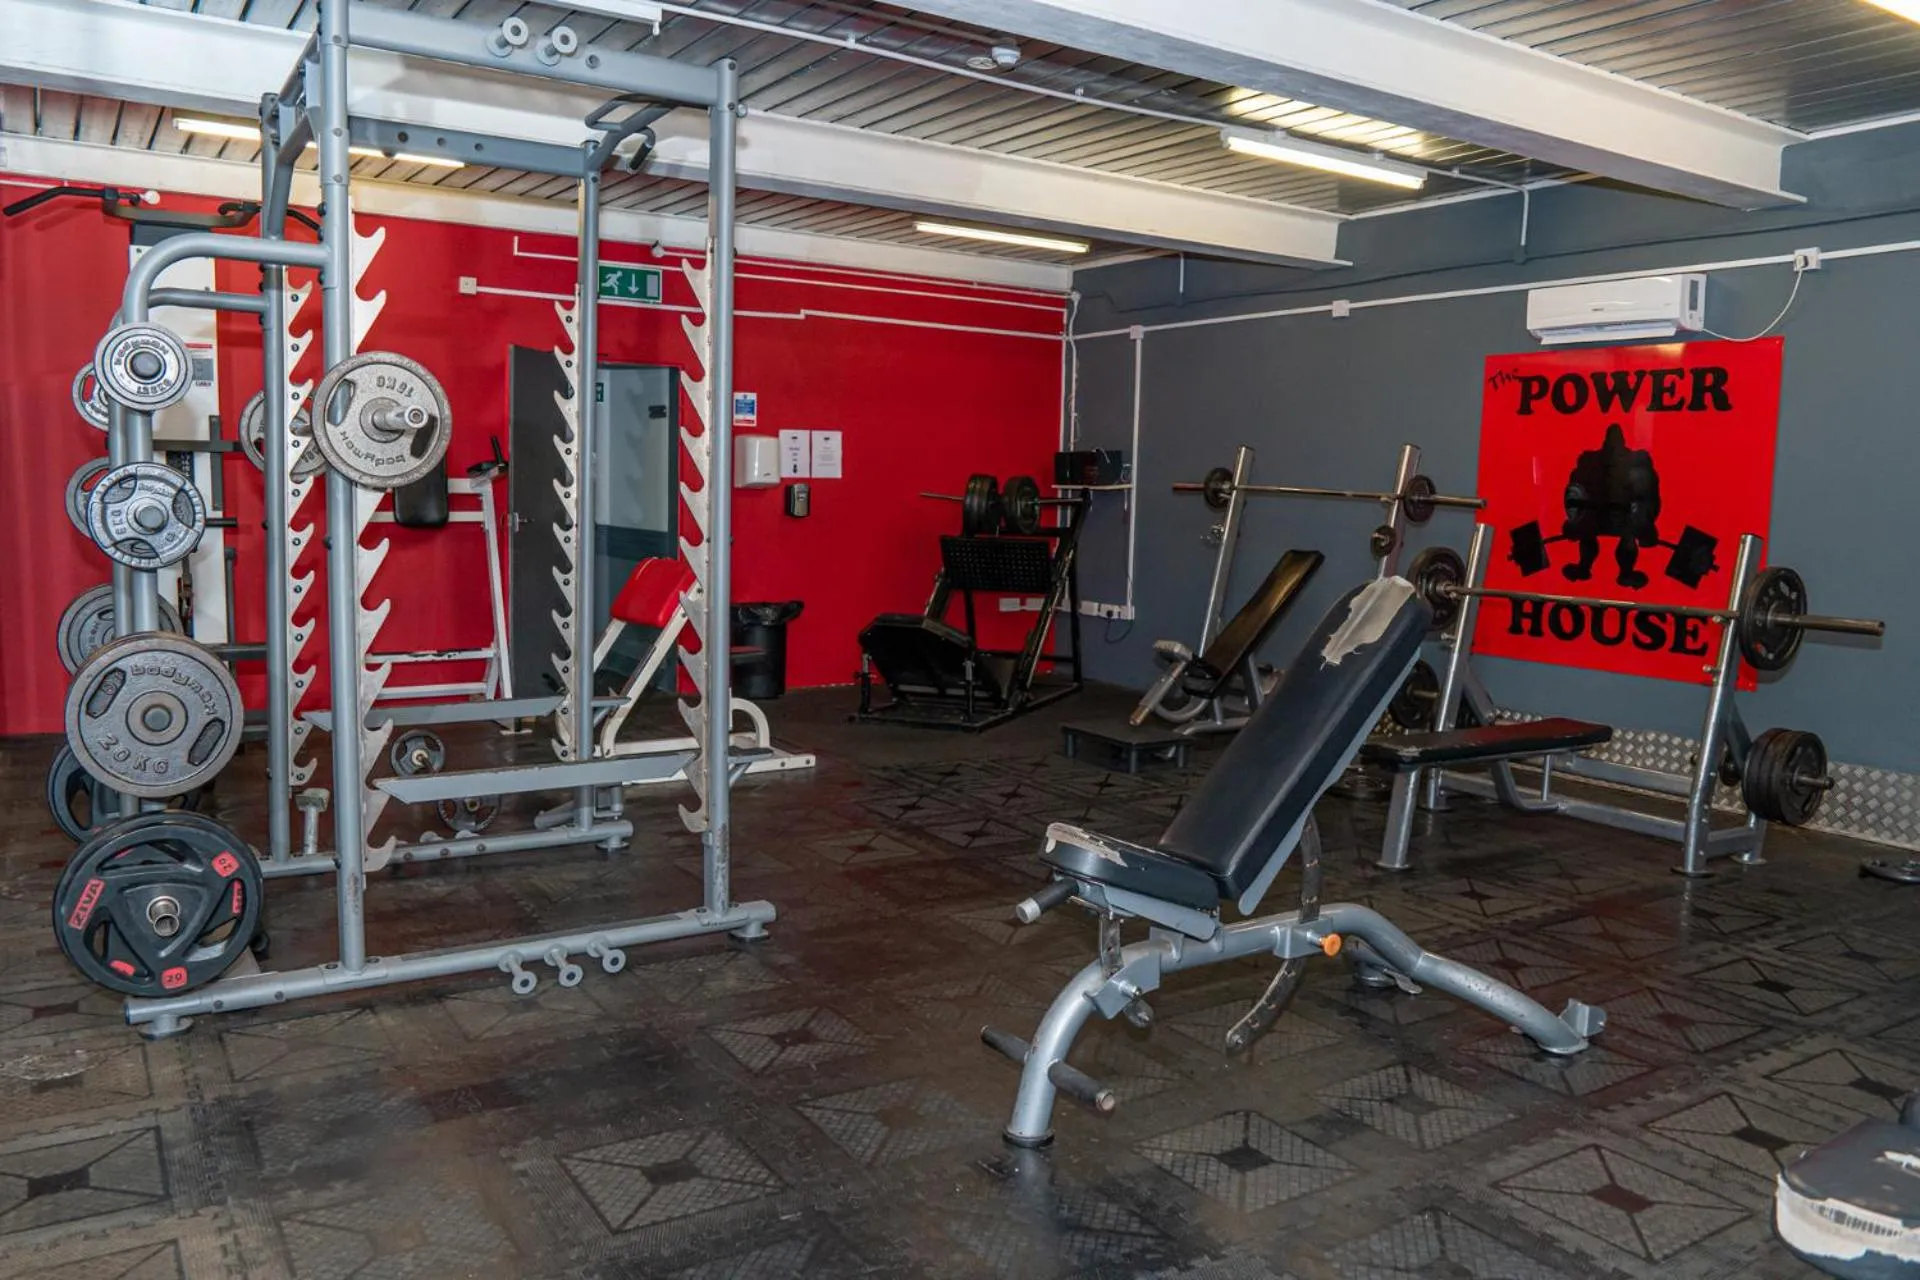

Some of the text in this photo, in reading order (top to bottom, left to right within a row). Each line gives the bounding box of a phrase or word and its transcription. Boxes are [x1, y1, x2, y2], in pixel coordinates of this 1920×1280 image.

[1516, 366, 1733, 415] POWER
[1508, 596, 1709, 657] HOUSE
[98, 734, 169, 775] 20KG
[74, 882, 102, 927] ZIVA
[167, 971, 182, 984] 20
